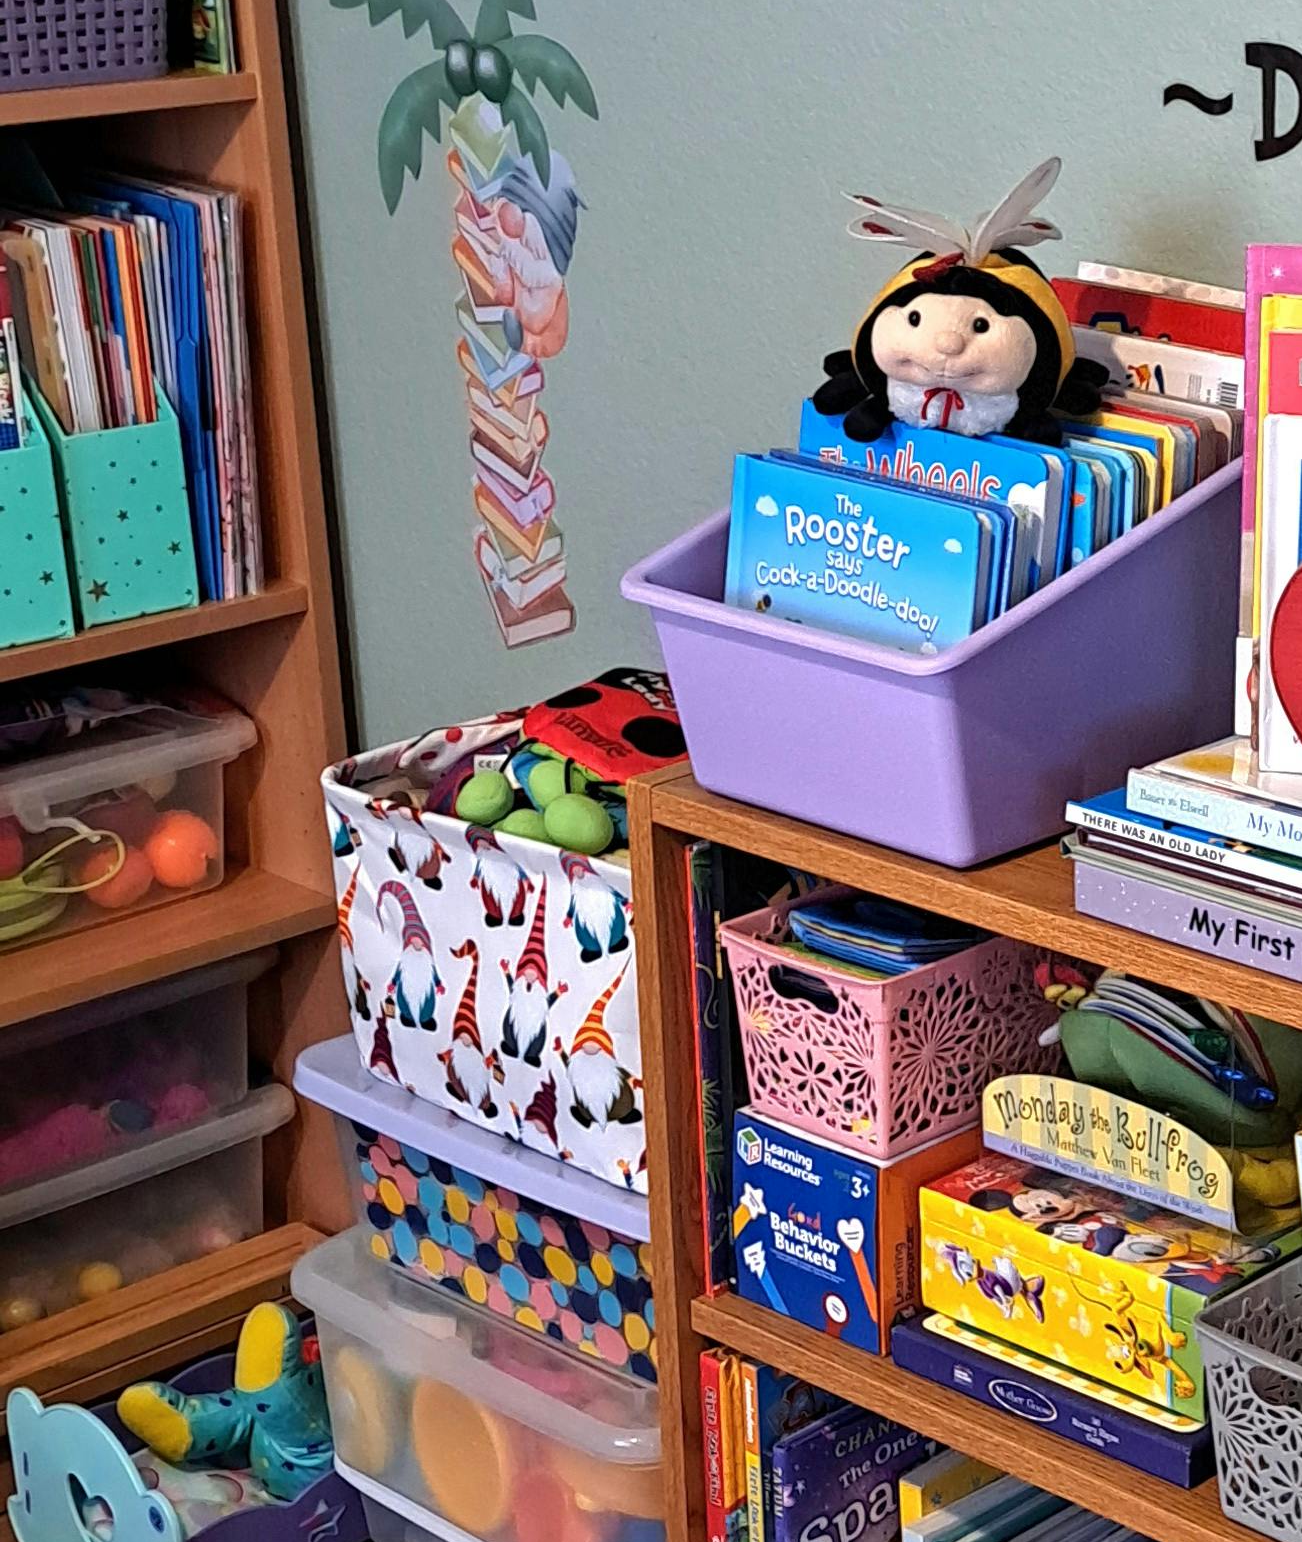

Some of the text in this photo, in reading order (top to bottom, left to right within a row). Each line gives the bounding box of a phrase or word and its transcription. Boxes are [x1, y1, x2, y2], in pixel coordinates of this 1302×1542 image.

[834, 493, 862, 518] The
[785, 505, 911, 569] Rooster
[826, 549, 863, 576] says
[756, 561, 940, 638] Cock-a-Doodle-doo!
[1082, 812, 1226, 863] THERE WAS AN OLD LADY
[1246, 811, 1273, 838] My
[1188, 906, 1226, 941] My
[1234, 918, 1295, 961] First
[764, 1138, 813, 1170] Learning
[994, 1083, 1220, 1199] Monday the Bullfrog
[1047, 1128, 1160, 1182] Matthew Van Fleet
[764, 1154, 822, 1186] Resources
[850, 1176, 871, 1199] 3+
[769, 1211, 841, 1256] Behavior
[774, 1232, 837, 1273] Buckets
[744, 1377, 755, 1444] nickelodeon
[838, 1432, 918, 1489] The One
[772, 1466, 785, 1518] TATUM
